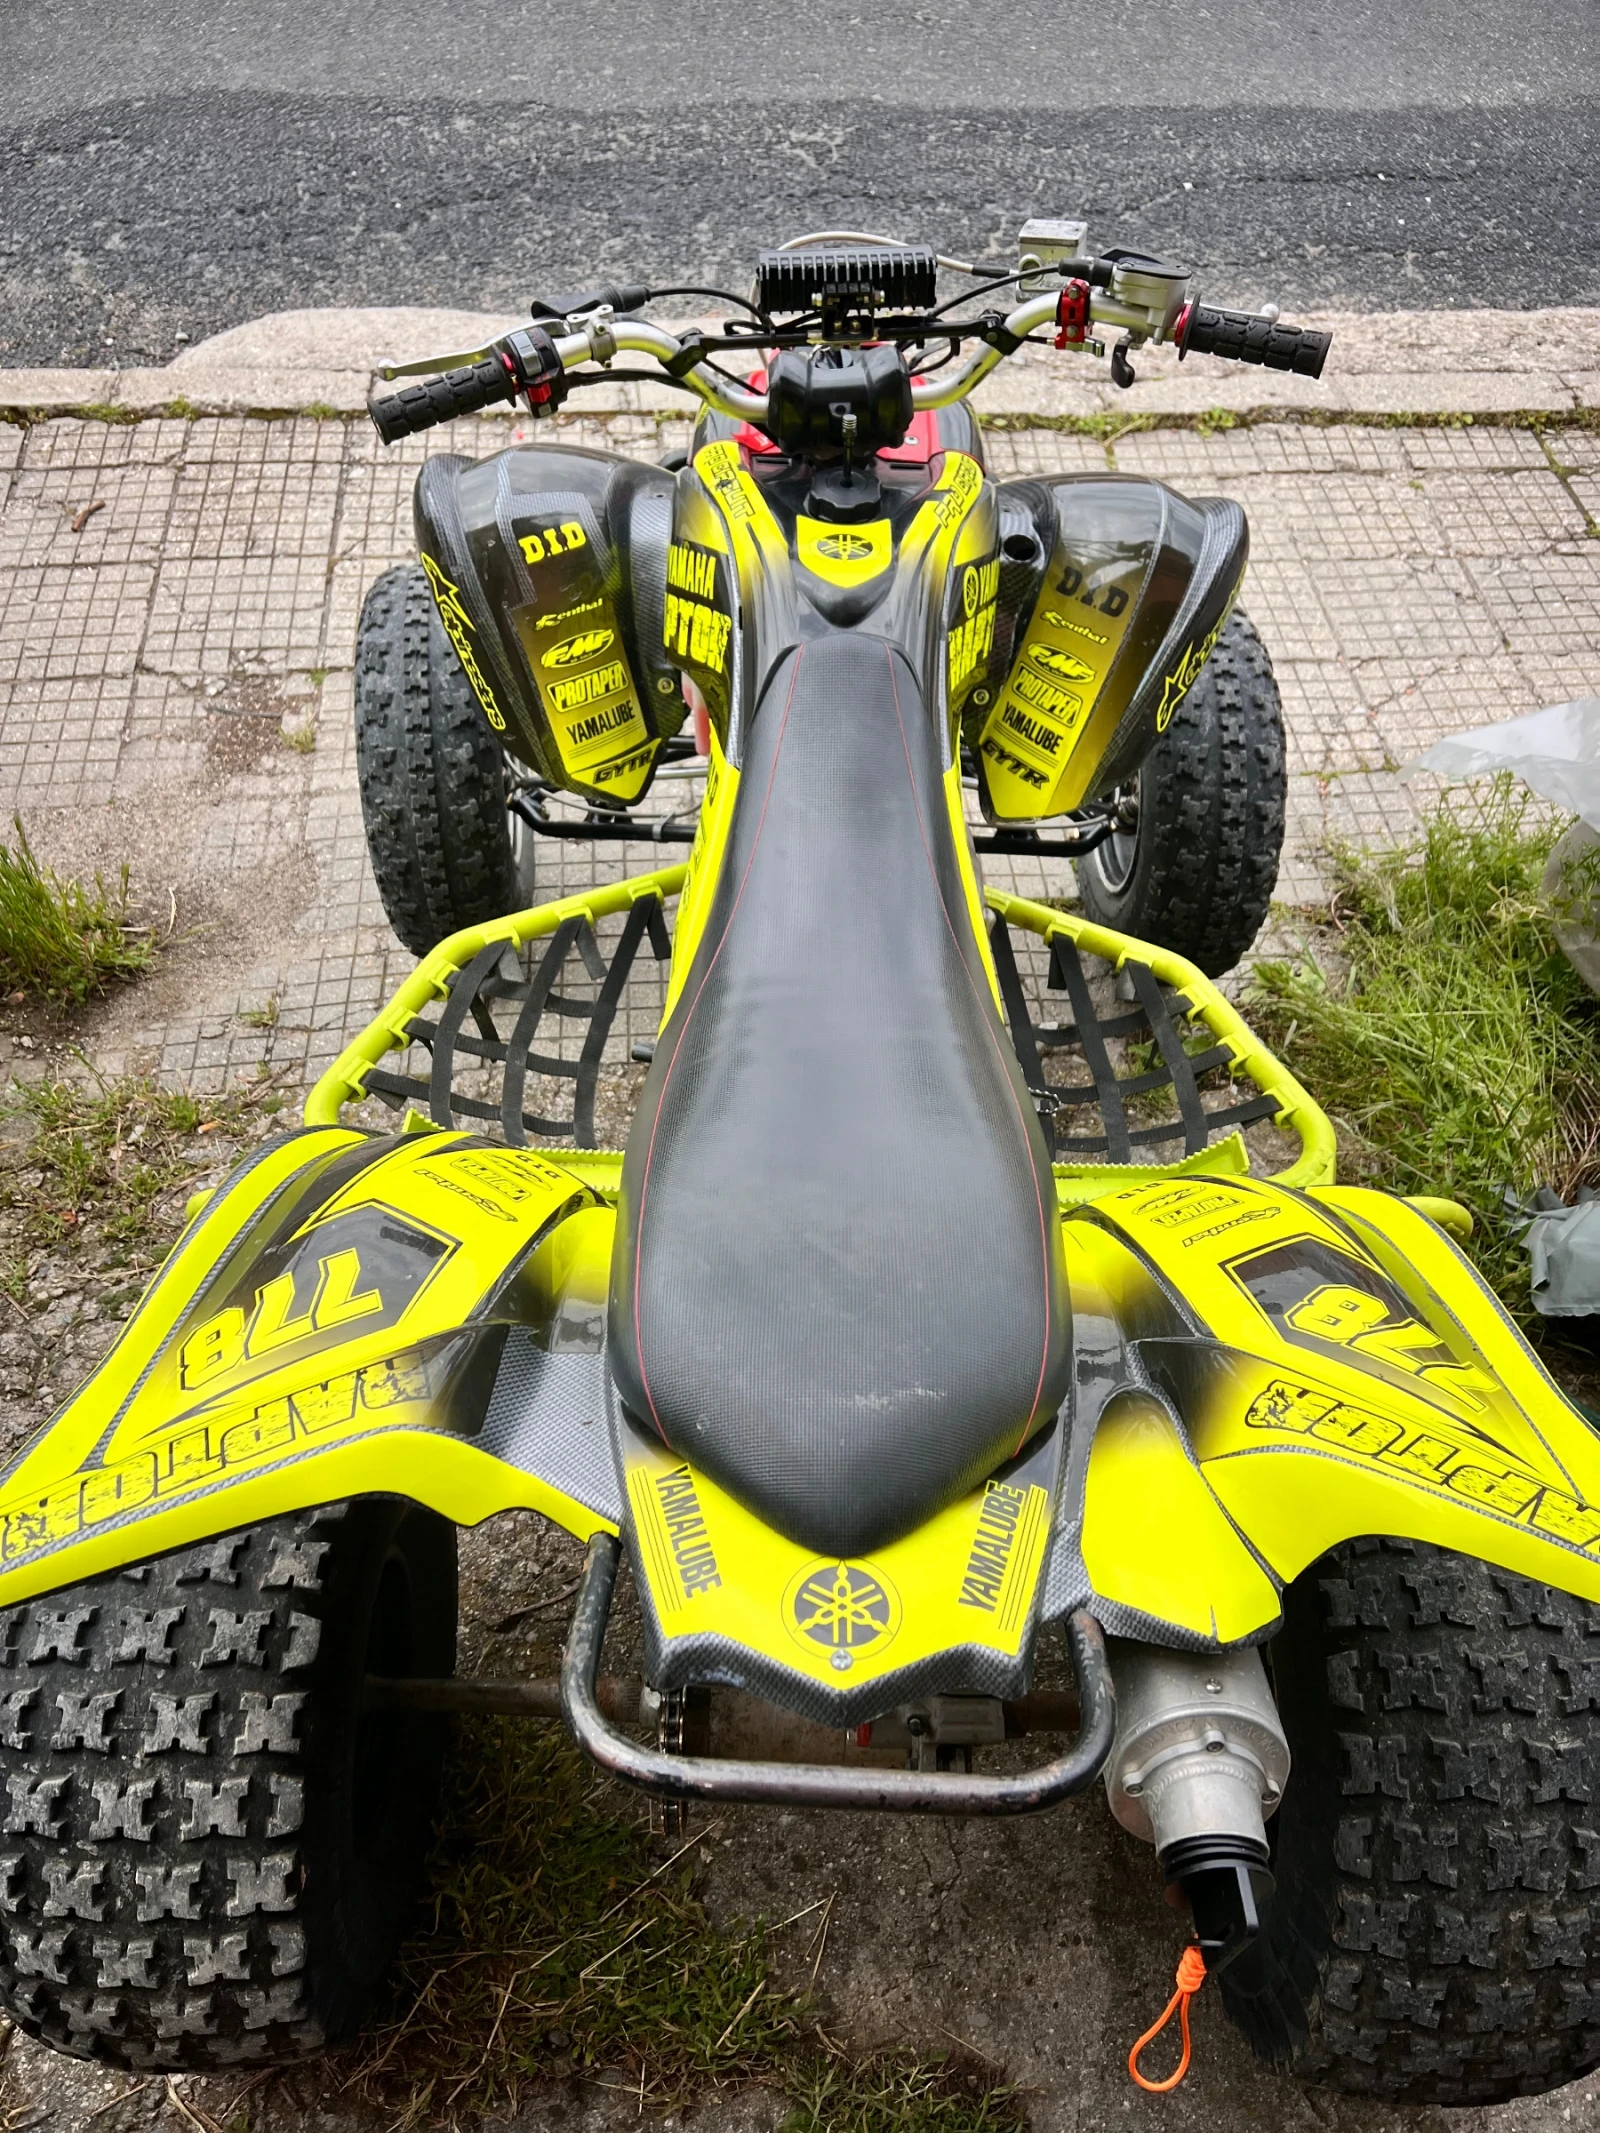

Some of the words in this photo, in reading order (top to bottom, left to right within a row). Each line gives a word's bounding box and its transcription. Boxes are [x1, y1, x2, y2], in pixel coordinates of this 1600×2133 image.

[518, 521, 587, 565] D.I.D
[1055, 566, 1130, 618] D.I.D
[541, 629, 615, 668] FMF
[663, 591, 732, 674] PTOR
[553, 664, 625, 712] PROTAPER
[1027, 641, 1097, 684] FMF
[565, 700, 636, 745] YAMALUBE
[1016, 668, 1077, 725] PROTAPER
[1000, 701, 1064, 755] YAMALUBE
[592, 748, 653, 785] GYTR
[982, 735, 1050, 790] GYTR
[178, 1247, 385, 1391] 778
[1282, 1283, 1500, 1414] 778
[1245, 1379, 1600, 1553] APTOR
[655, 1462, 724, 1599] YAMALUBE
[957, 1480, 1027, 1613] YAMALUBE
